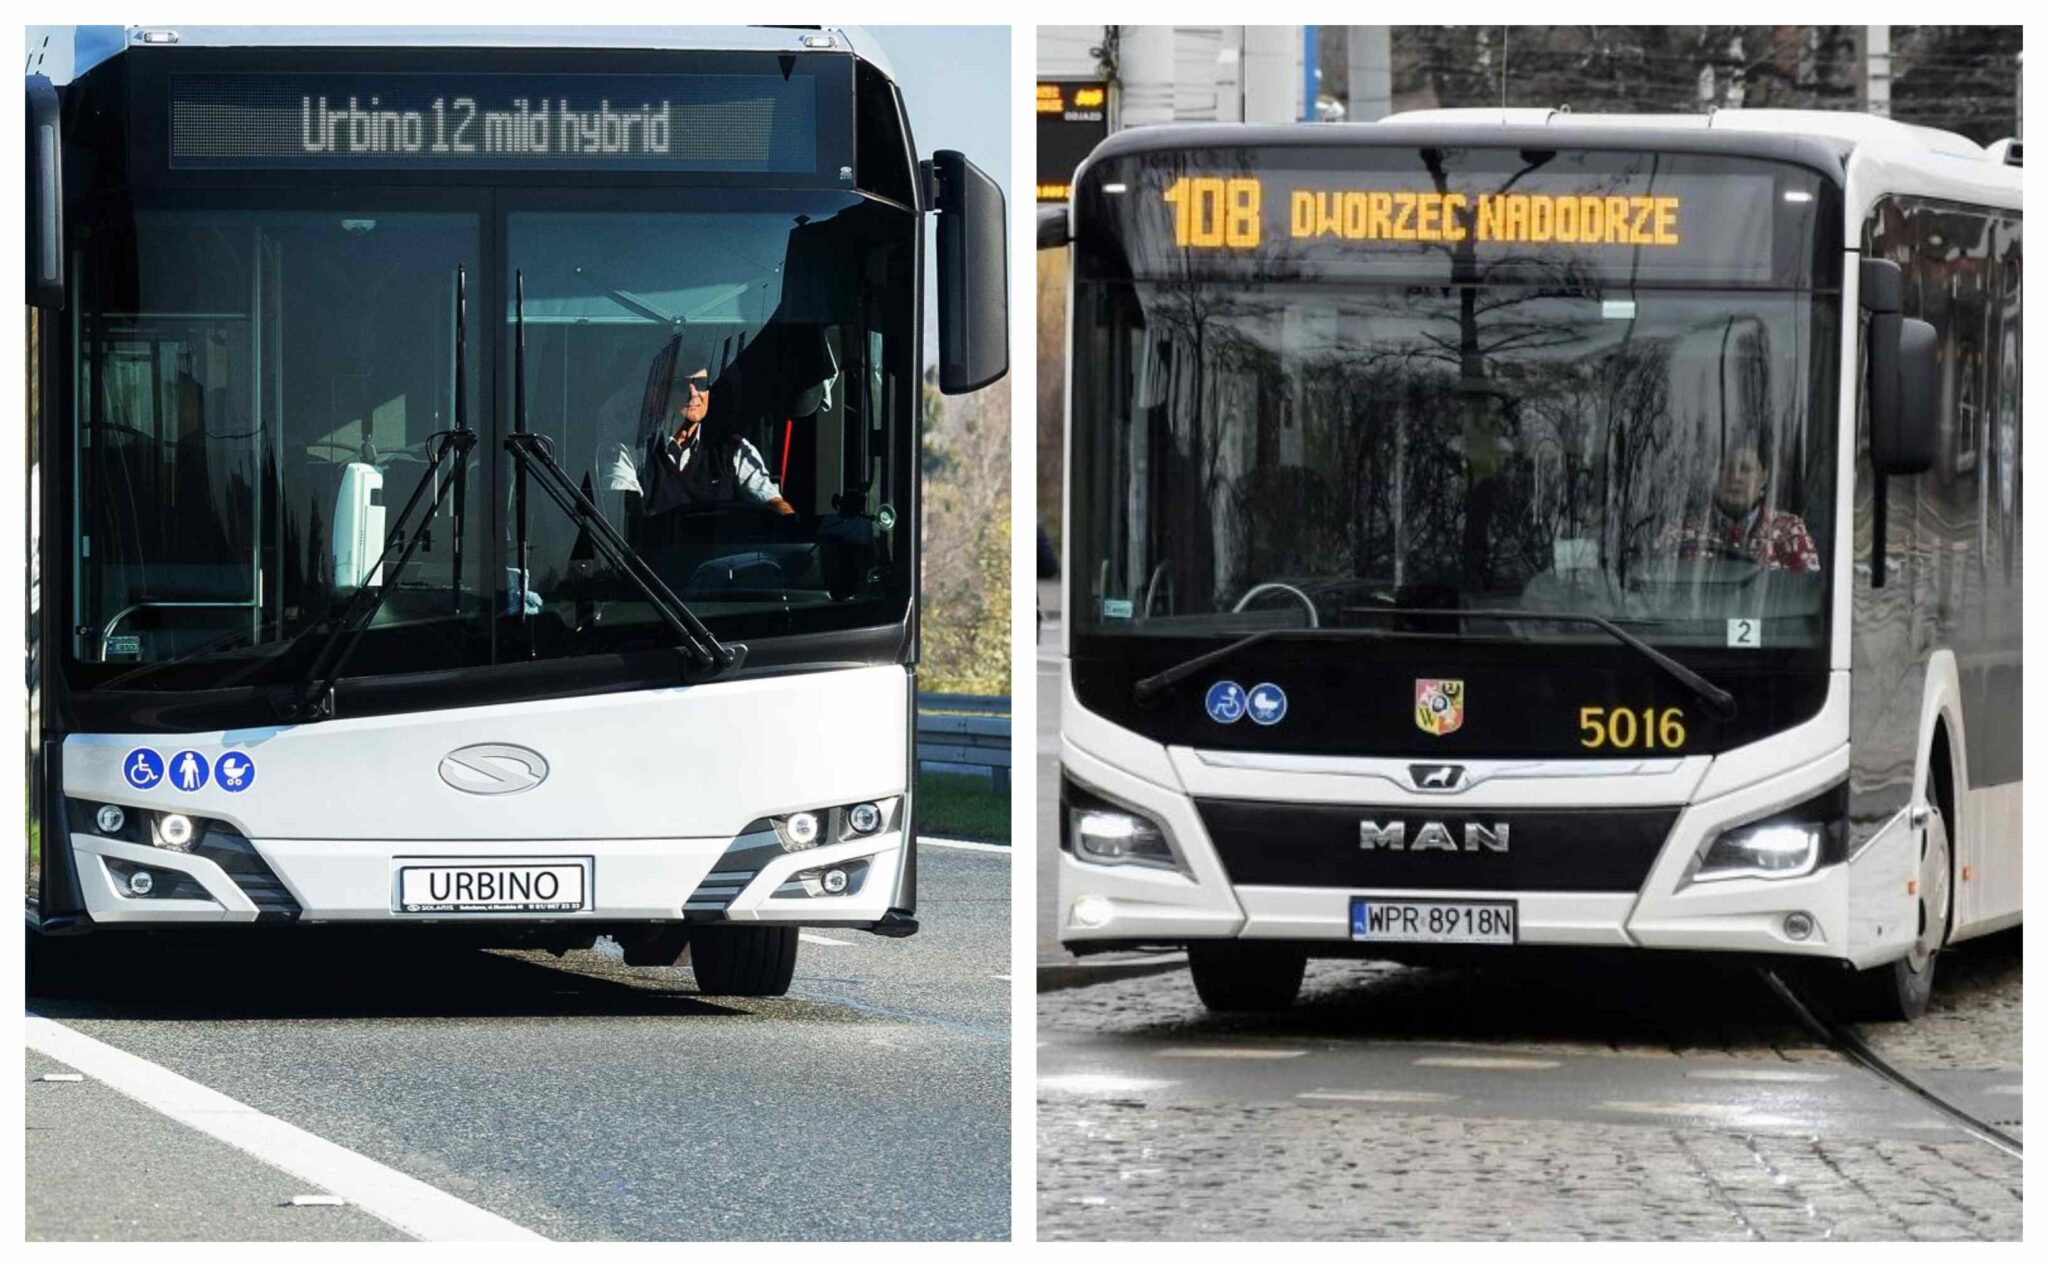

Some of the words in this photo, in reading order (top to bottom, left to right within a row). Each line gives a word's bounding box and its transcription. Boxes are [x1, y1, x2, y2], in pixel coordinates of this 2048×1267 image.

[303, 97, 421, 151] Urbino
[432, 98, 475, 151] 12
[485, 99, 549, 152] mild
[560, 99, 669, 152] hybrid
[1164, 177, 1261, 247] 108
[1290, 190, 1468, 242] DWORZEC
[1477, 193, 1679, 244] NADODRZE
[1737, 620, 1751, 643] 2
[1580, 707, 1686, 748] 5016
[1360, 820, 1510, 852] MAN
[430, 871, 559, 901] URBINO
[1368, 906, 1419, 933] WPR
[1429, 907, 1511, 935] 8918N
